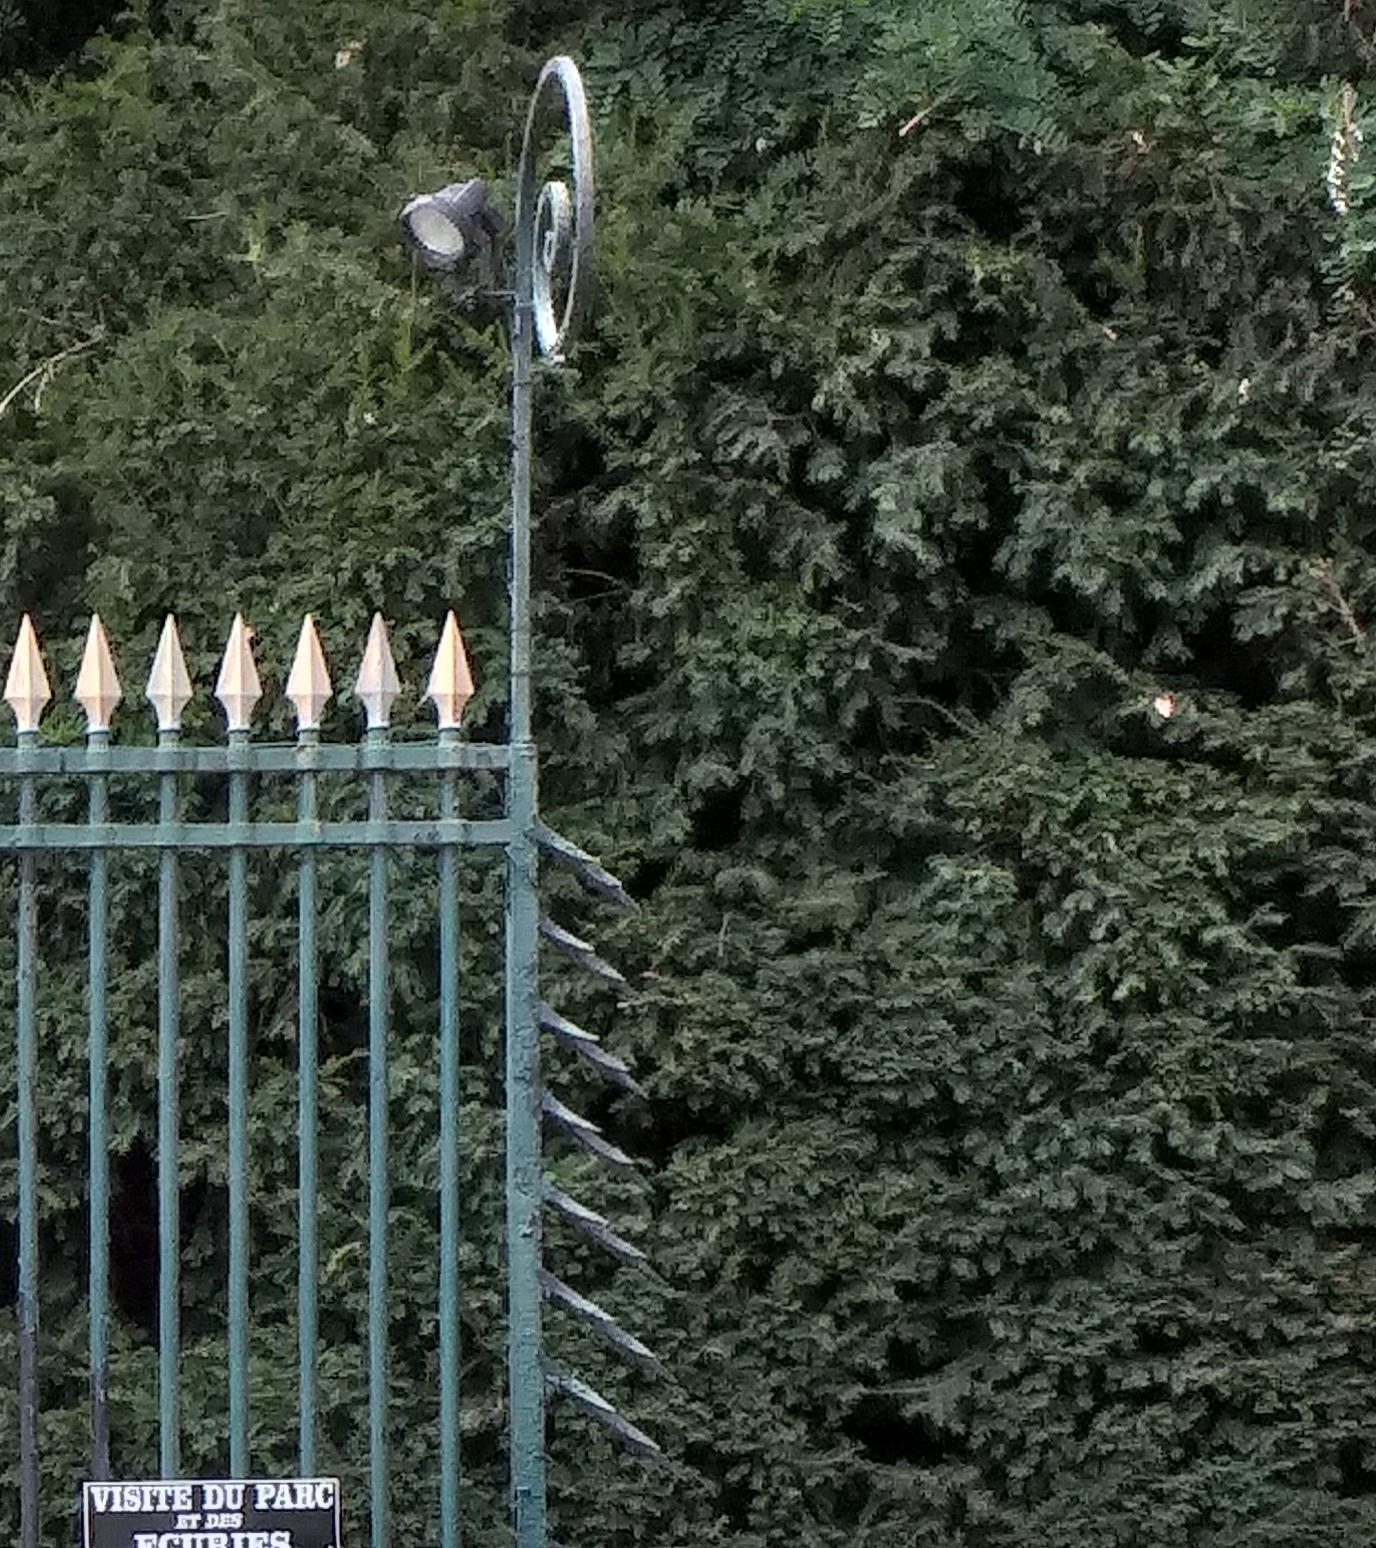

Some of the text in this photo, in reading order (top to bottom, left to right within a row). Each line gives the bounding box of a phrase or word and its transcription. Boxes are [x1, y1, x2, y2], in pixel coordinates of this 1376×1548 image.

[90, 1484, 334, 1512] VISITE DU PARC
[174, 1513, 244, 1530] ET DES
